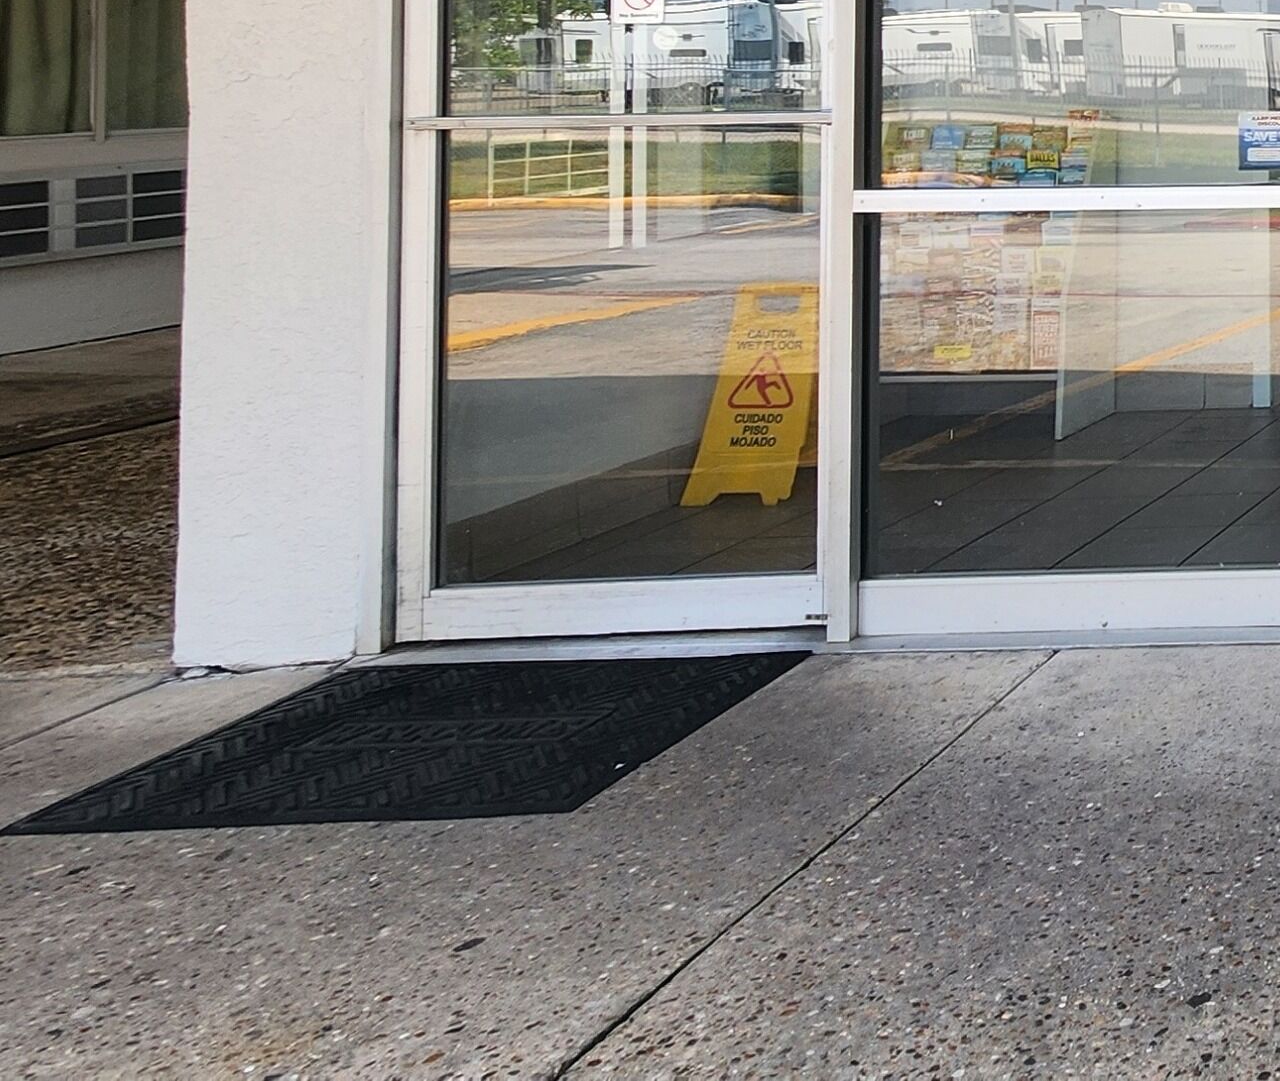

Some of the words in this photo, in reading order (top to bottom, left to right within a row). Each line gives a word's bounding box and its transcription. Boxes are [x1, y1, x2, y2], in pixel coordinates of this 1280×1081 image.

[1243, 131, 1277, 142] SAVE
[747, 329, 796, 339] CAUTION
[737, 340, 761, 350] WET
[763, 340, 803, 350] FLOOR
[734, 413, 783, 424] CUIDADO
[742, 425, 769, 435] PISO
[729, 436, 777, 447] MOJADO
